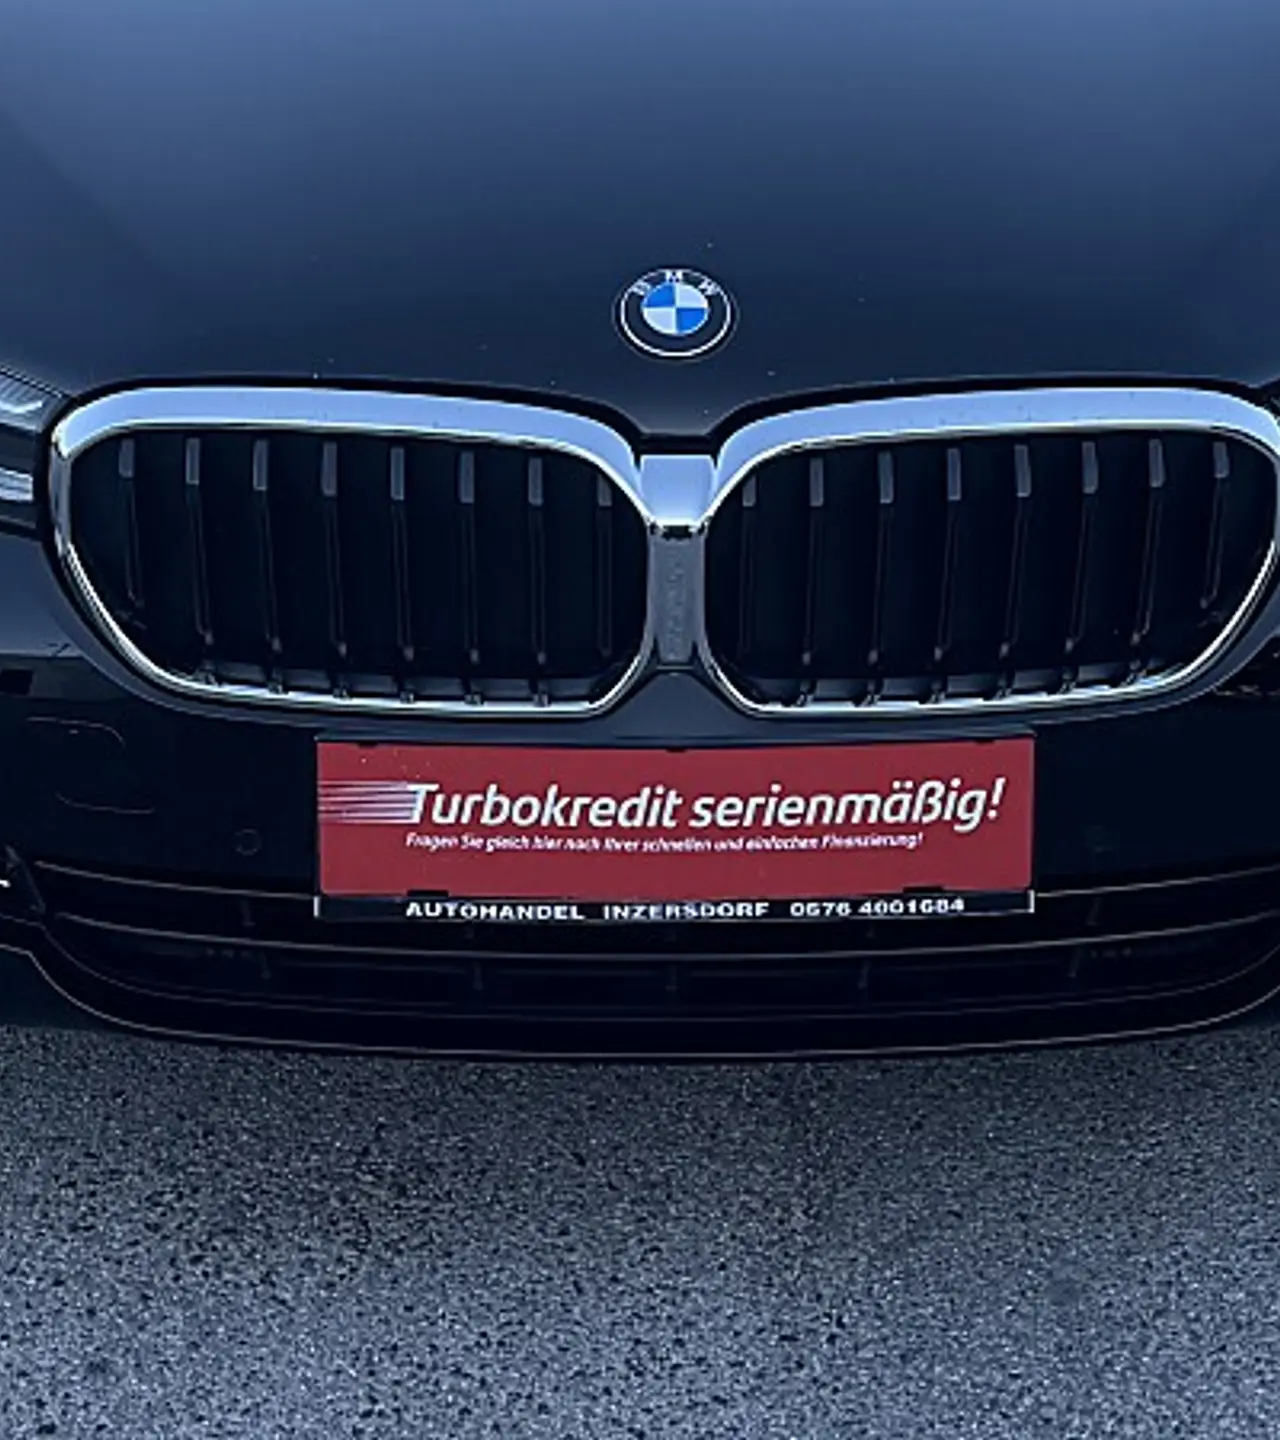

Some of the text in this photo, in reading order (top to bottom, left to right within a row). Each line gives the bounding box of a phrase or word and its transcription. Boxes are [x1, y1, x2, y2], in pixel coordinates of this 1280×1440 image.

[407, 777, 1006, 833] Turbokredit serienmäßig!
[406, 902, 585, 921] AUTOHANDEL
[603, 902, 770, 920] INZERSDORF
